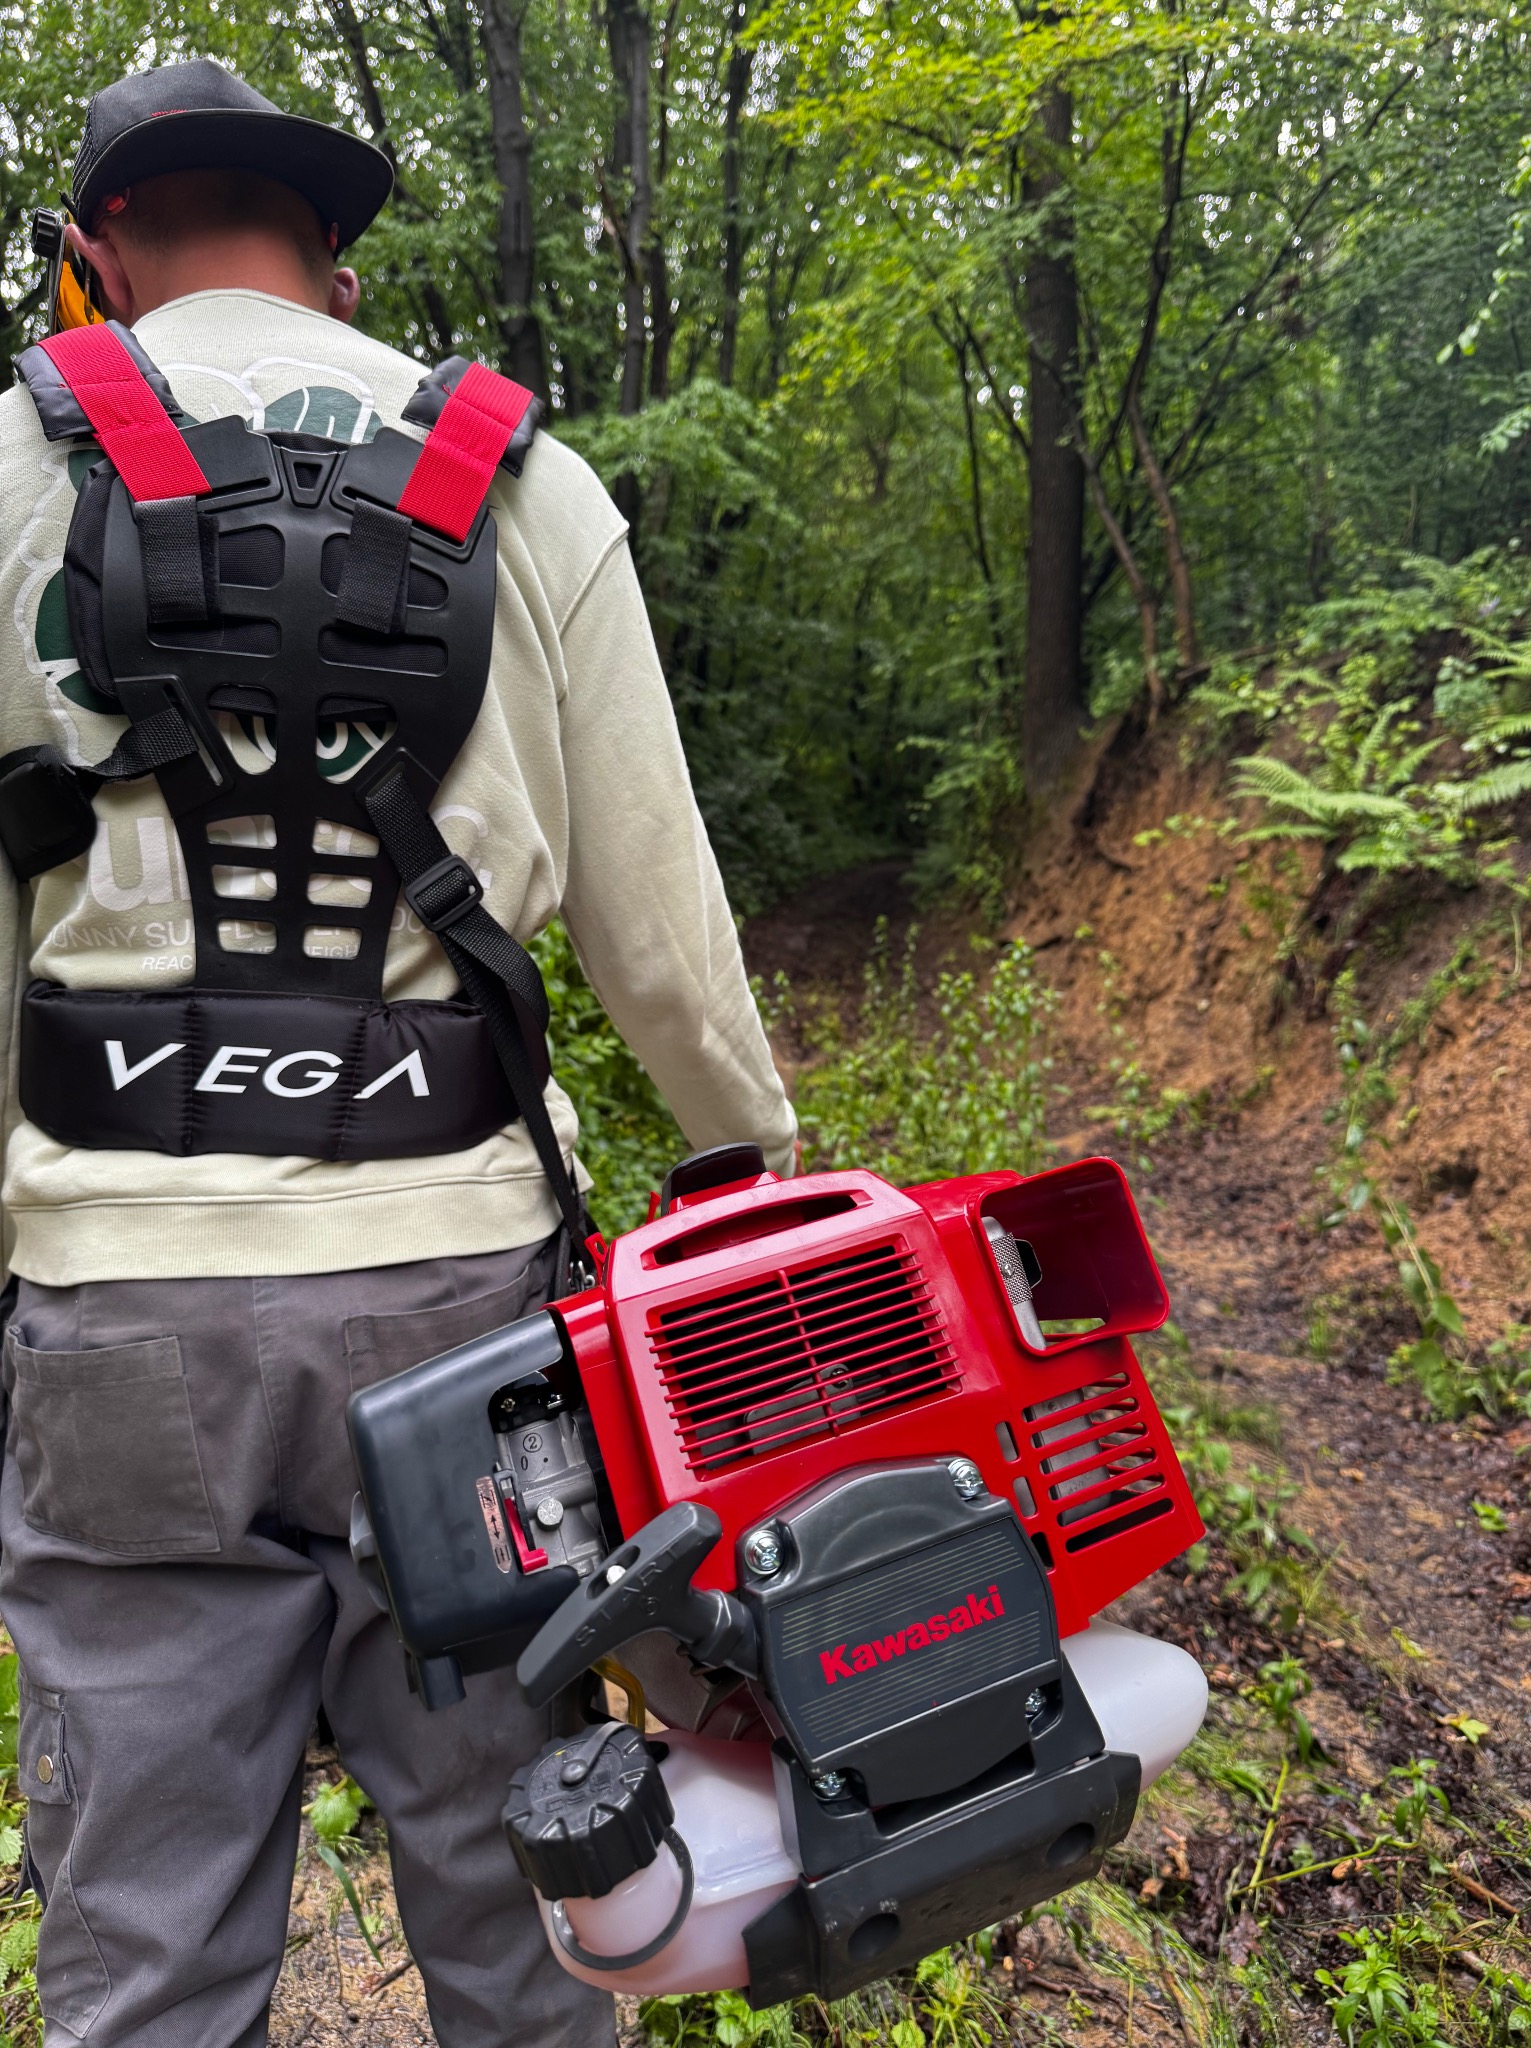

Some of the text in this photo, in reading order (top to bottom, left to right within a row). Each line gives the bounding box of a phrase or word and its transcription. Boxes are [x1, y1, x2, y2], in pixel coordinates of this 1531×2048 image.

[49, 922, 138, 949] UNNY
[141, 954, 194, 972] REAC
[104, 1039, 430, 1100] VEGA
[818, 1584, 1006, 1685] Kawasaki
